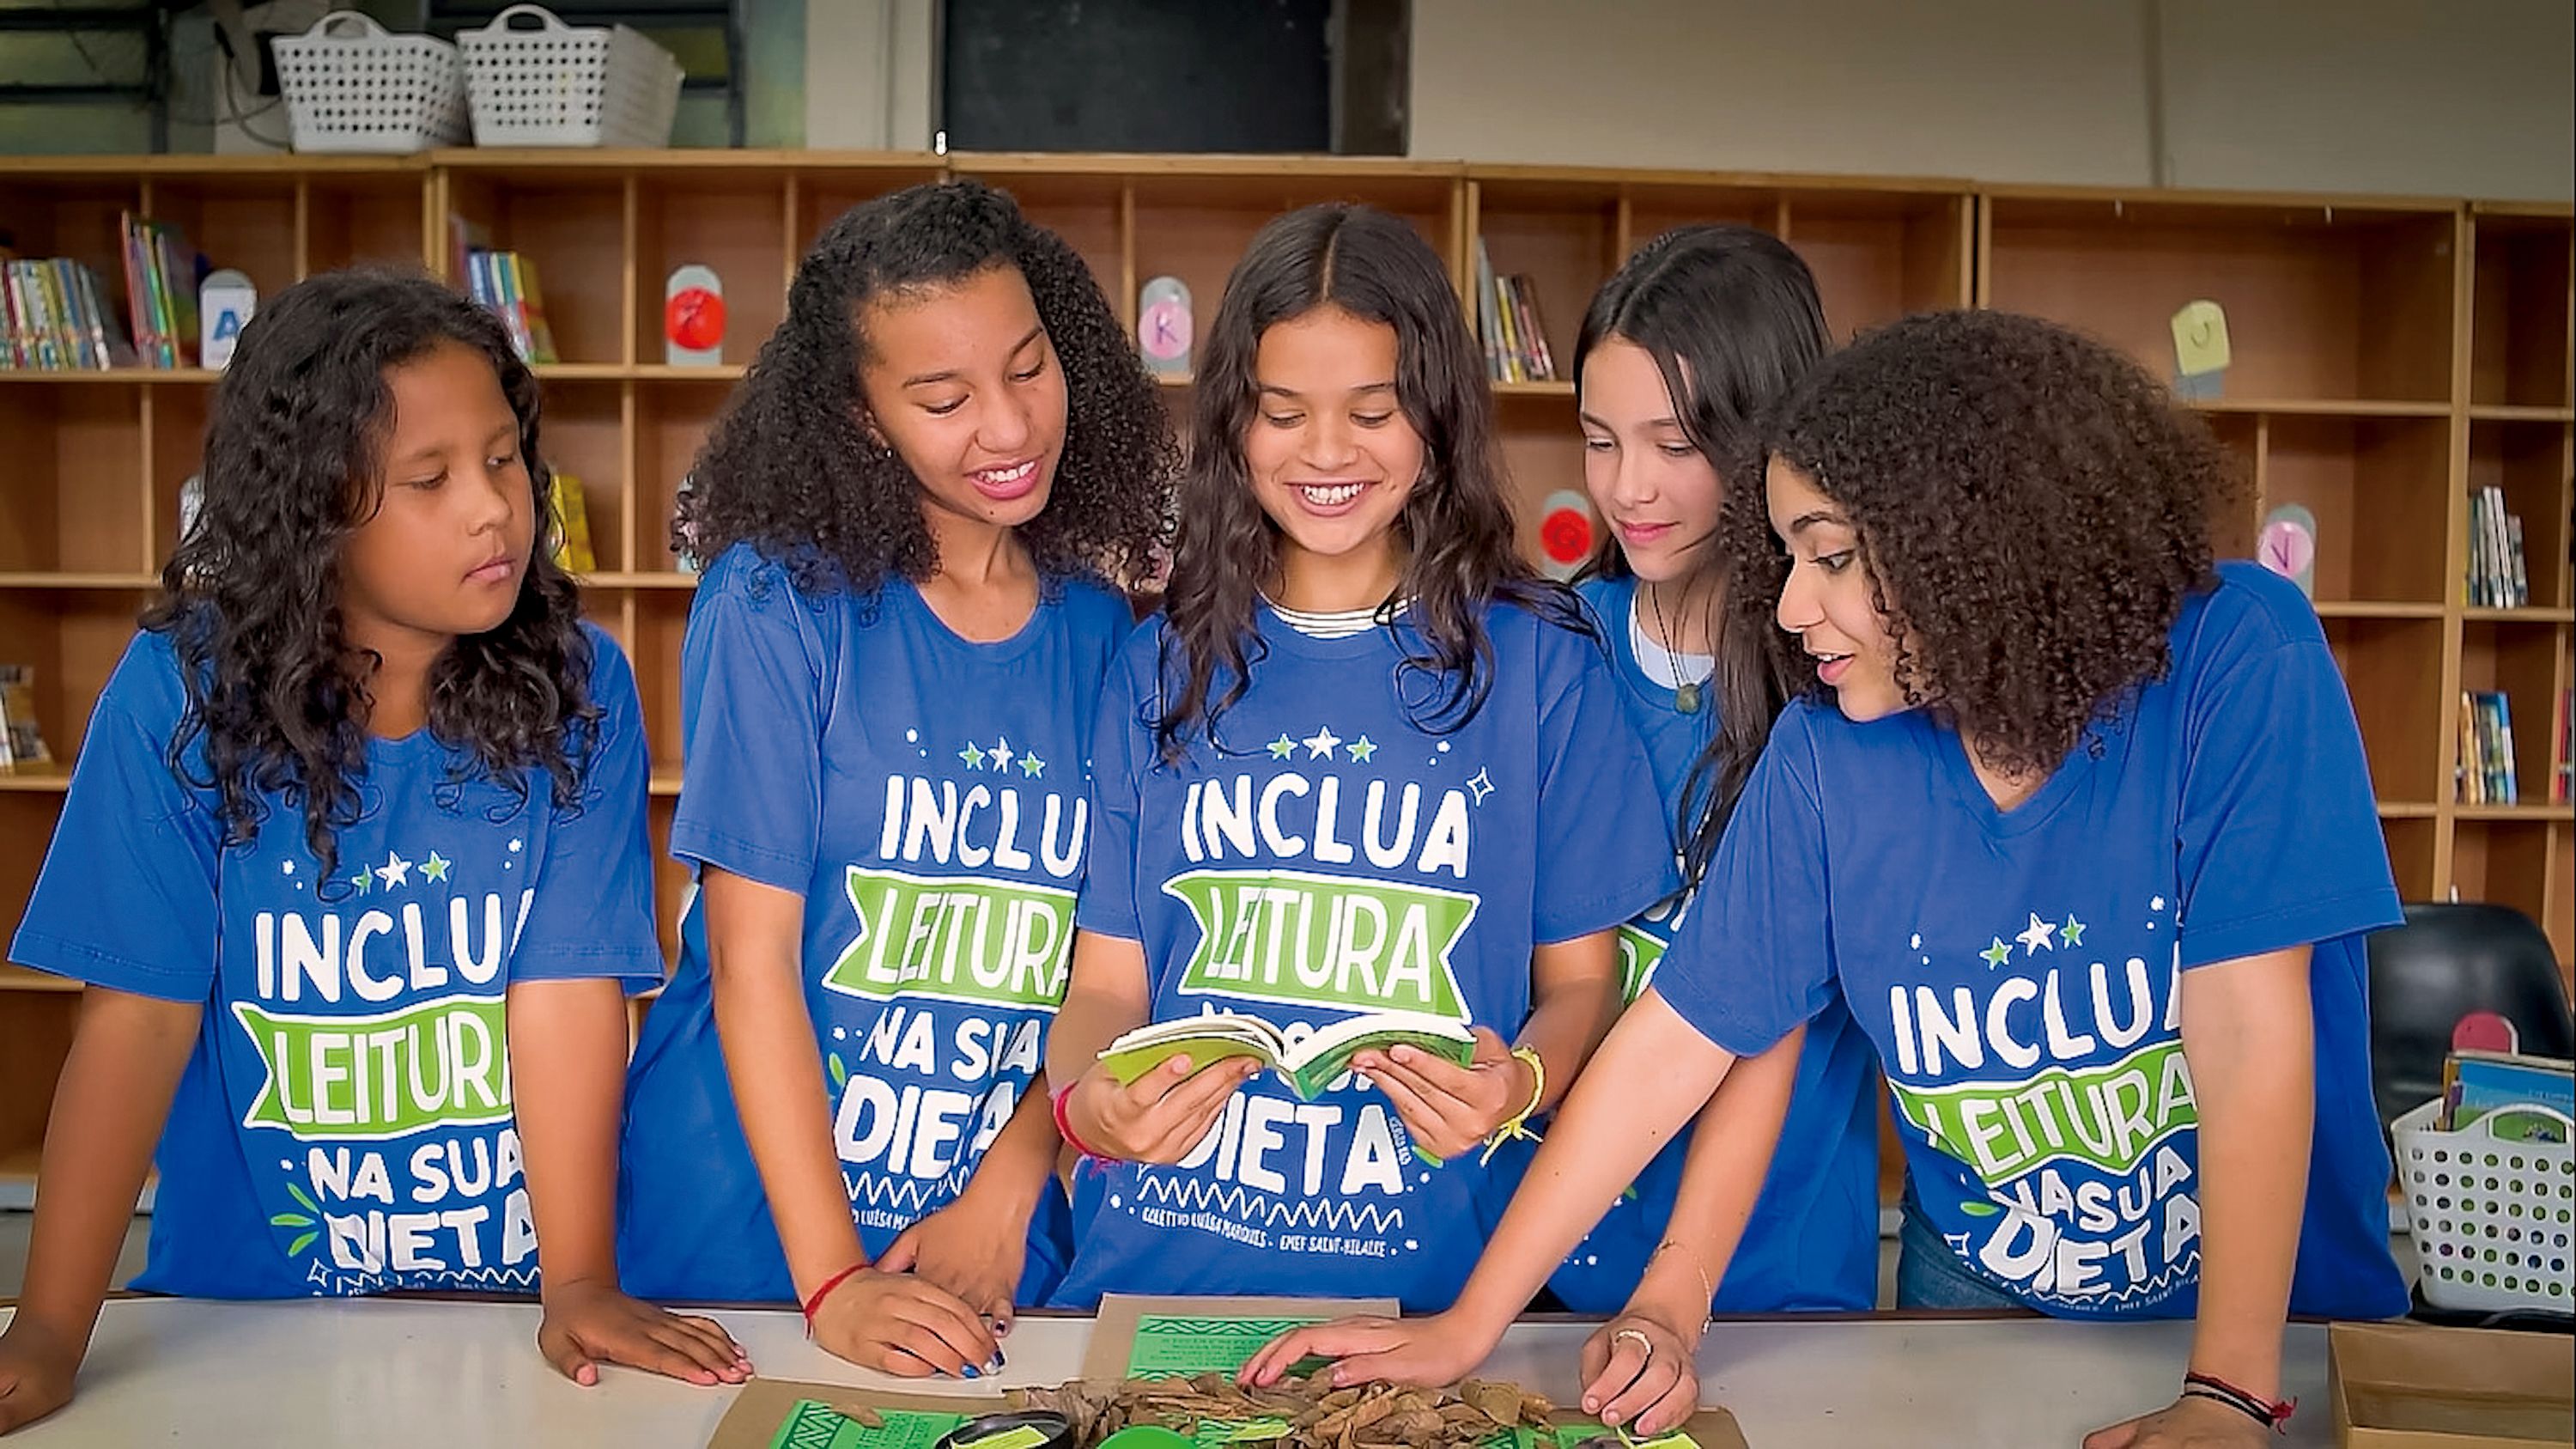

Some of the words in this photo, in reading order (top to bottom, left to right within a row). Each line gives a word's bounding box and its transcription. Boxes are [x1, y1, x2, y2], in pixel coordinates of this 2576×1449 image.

[1156, 312, 1178, 344] K
[879, 774, 1089, 878] INCLU
[1181, 772, 1470, 879] INCLUA
[1203, 885, 1432, 1003] LEITURA
[274, 1010, 512, 1124] LEITUR
[859, 1006, 935, 1075] NA
[307, 1146, 395, 1205] NA
[409, 1128, 526, 1203] SUA
[2076, 1145, 2192, 1233] SUA
[323, 1187, 539, 1275] DIETA
